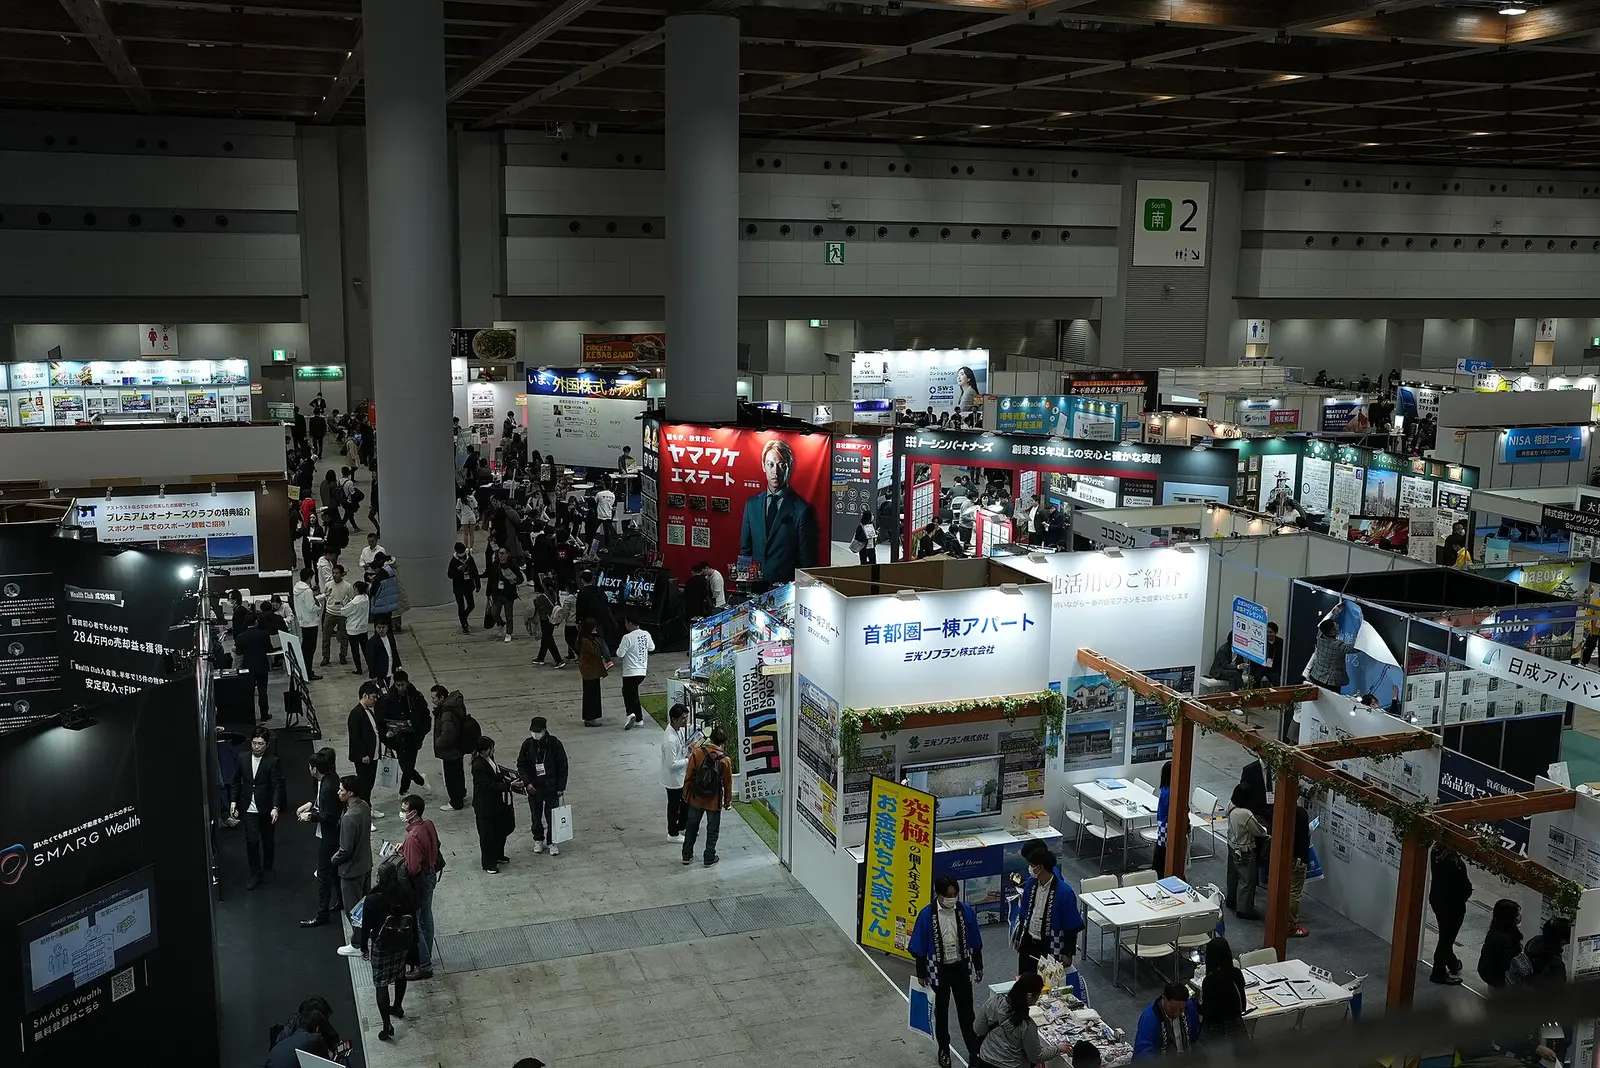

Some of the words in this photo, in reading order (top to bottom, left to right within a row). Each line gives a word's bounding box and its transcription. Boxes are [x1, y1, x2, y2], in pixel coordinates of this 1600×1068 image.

[1151, 211, 1165, 228] 南
[1180, 199, 1198, 231] 2
[585, 351, 612, 359] KEBAB
[612, 351, 635, 359] SAND
[918, 439, 995, 459] トーシンパートナーズ
[1508, 435, 1531, 446] NISA
[1533, 433, 1581, 446] 相談コーナー
[667, 443, 740, 467] ヤマワケ
[1011, 444, 1163, 465] 創業35年以上の安心と確かな実績
[1372, 454, 1409, 467] PICASSO
[670, 467, 736, 487] エステート
[106, 507, 251, 523] プレミアムオーナーズクラブの特典紹介
[107, 520, 231, 533] スポンサー席でのスポーツ観戦ご招待！
[1101, 526, 1136, 549] ココミンカ
[1520, 568, 1565, 584] nagoya
[863, 612, 1035, 646] 首都圏一棟アパート
[1495, 614, 1530, 634] kobe
[903, 644, 996, 663] 三光ソフラン株式会社
[749, 664, 761, 711] TRAILER
[757, 648, 768, 709] VACATION
[742, 673, 752, 714] HOUSE
[764, 674, 776, 708] LONG
[922, 733, 990, 748] 三光ソフラン株式会社
[33, 831, 100, 867] SMARG
[105, 814, 142, 838] Wealth
[33, 1003, 69, 1029] SMARG
[73, 986, 102, 1007] Wealth
[34, 1001, 100, 1043] 無料登録はこちら
